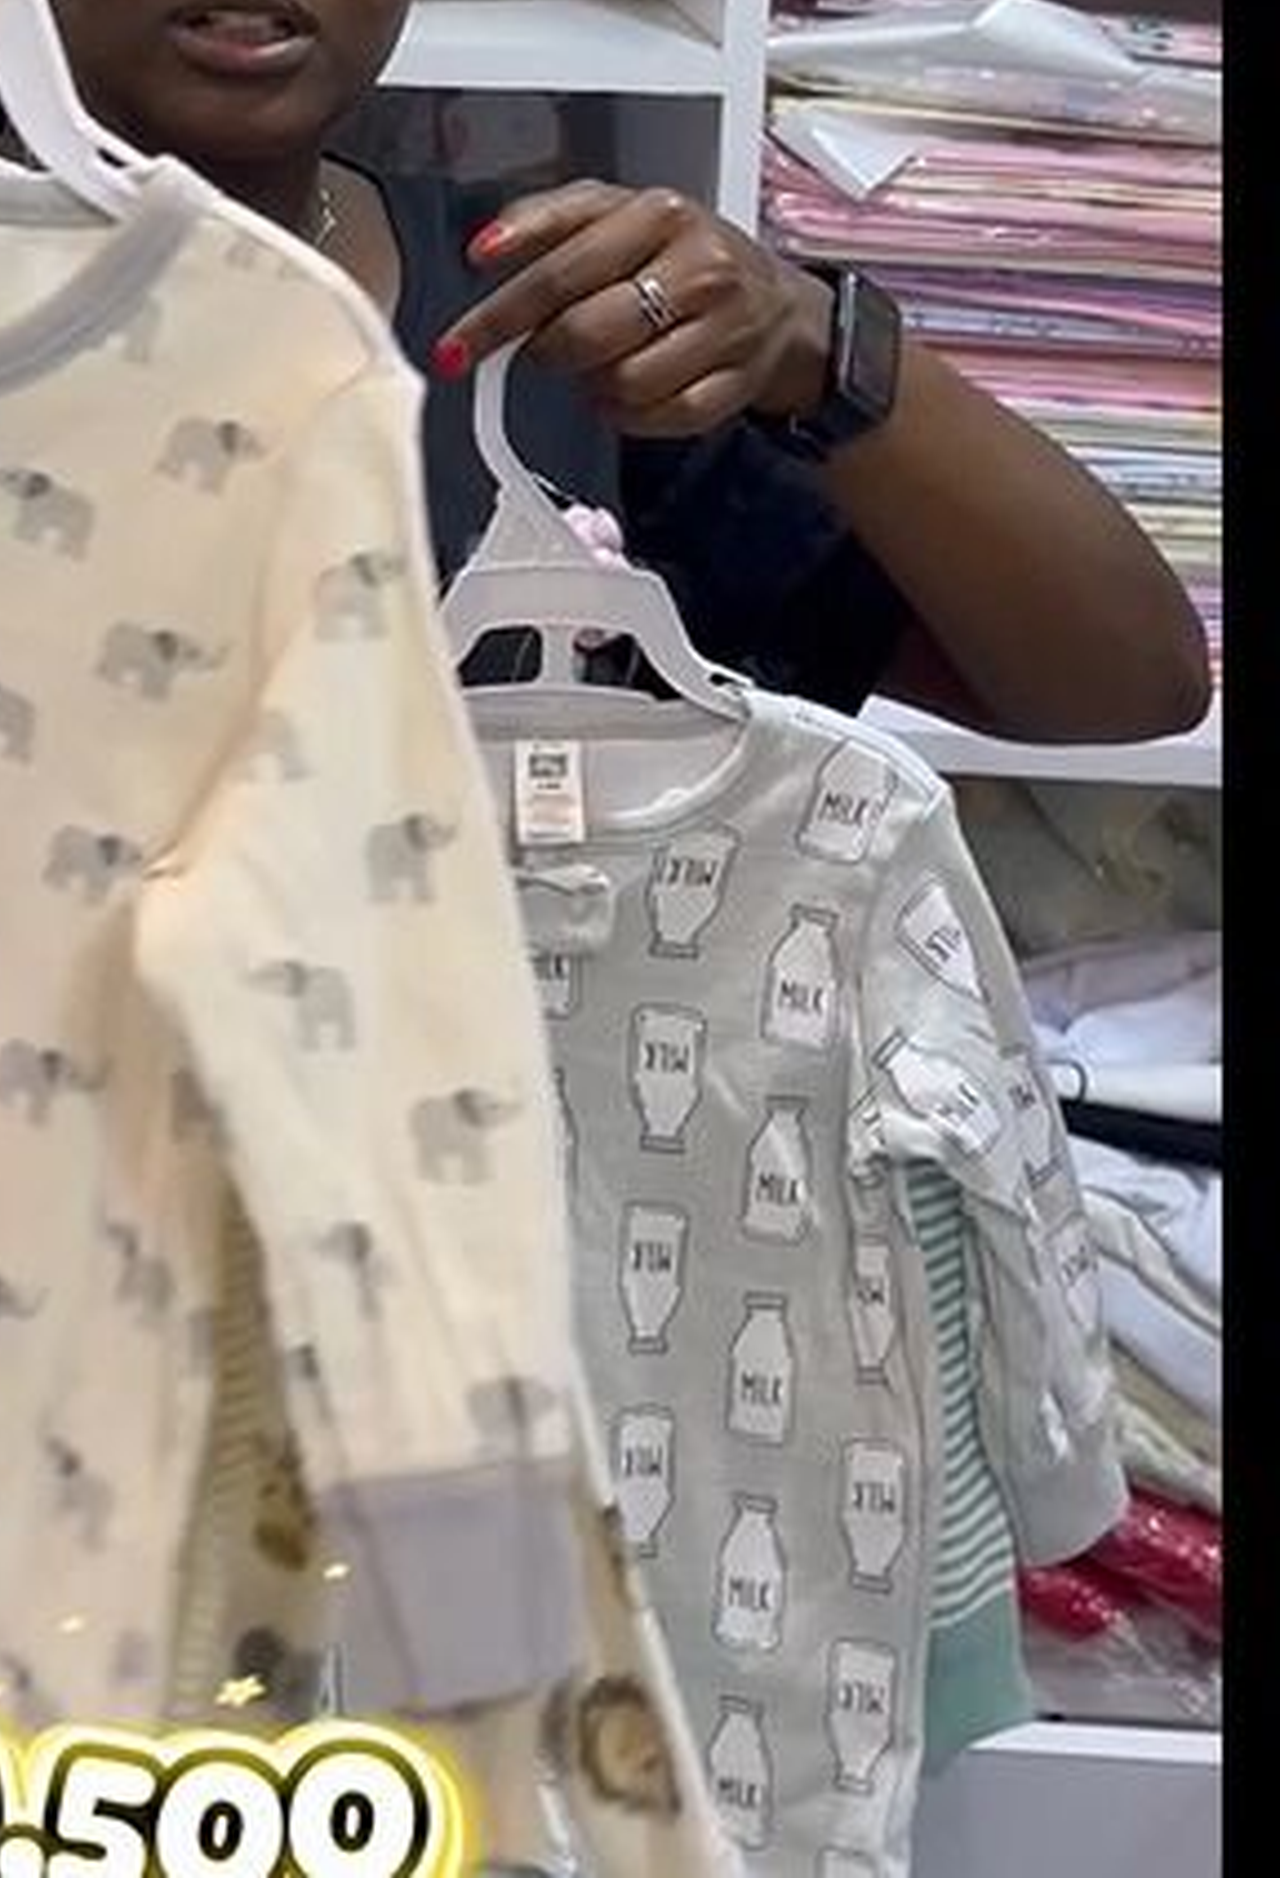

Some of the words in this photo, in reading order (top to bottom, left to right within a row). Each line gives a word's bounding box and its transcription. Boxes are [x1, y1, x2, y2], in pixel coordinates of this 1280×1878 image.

[779, 980, 824, 1018] MILK
[643, 1042, 690, 1074] MILK
[756, 1174, 799, 1206] MILK
[741, 1371, 782, 1406] MILK
[854, 1482, 896, 1513] MILK
[728, 1579, 771, 1612] MILK
